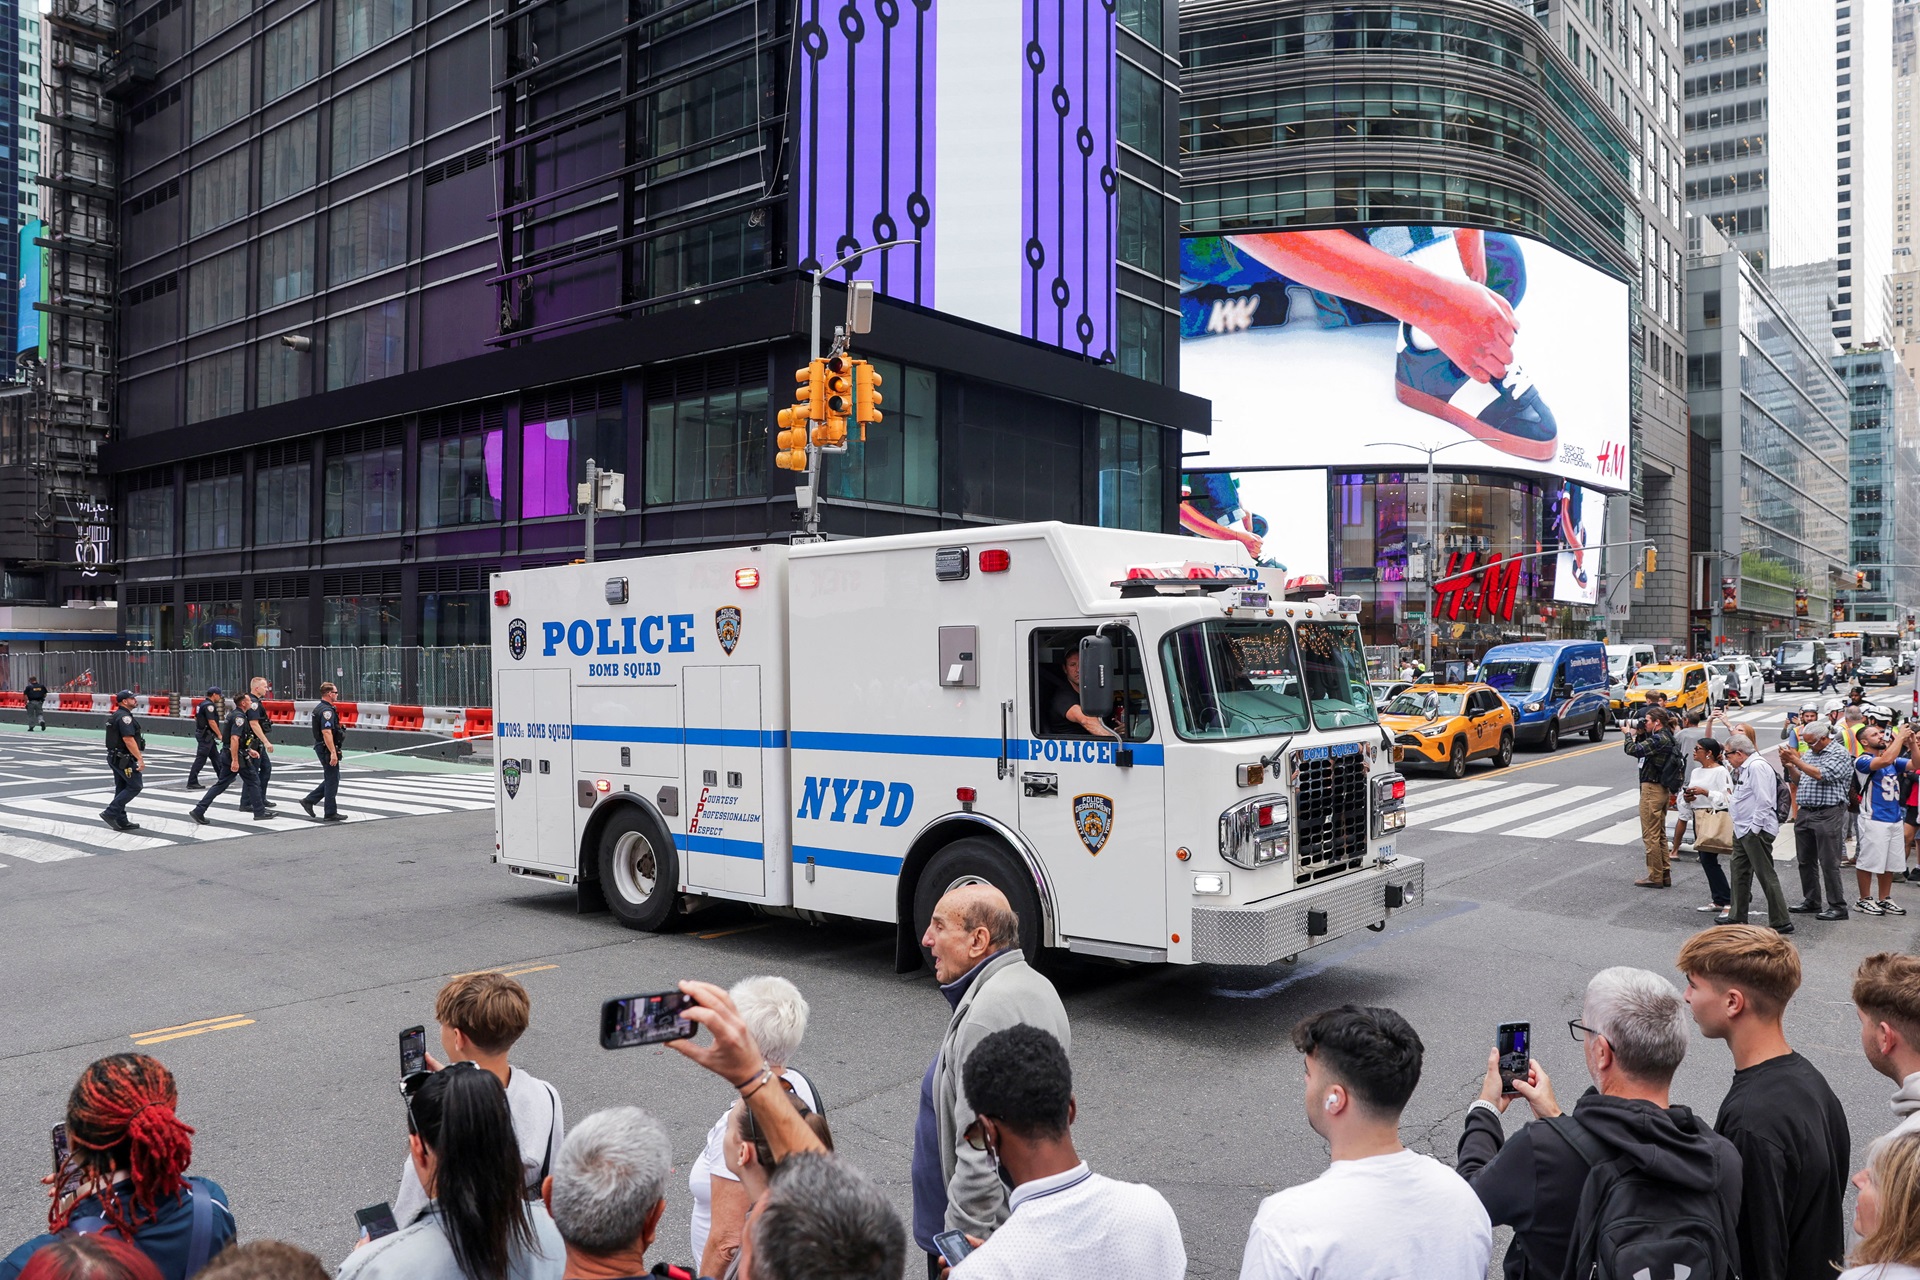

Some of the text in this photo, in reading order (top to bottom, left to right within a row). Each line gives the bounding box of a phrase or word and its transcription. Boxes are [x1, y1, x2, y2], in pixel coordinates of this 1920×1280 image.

[1596, 439, 1626, 481] H&M
[1432, 551, 1523, 621] H&M
[542, 613, 695, 657] POLICE
[589, 662, 661, 679] BOMB SQUAD
[505, 722, 521, 738] 7093
[527, 722, 546, 739] BOMB
[548, 723, 571, 743] SQUAD
[1030, 739, 1110, 764] POLICE
[1303, 747, 1329, 760] BOMB
[1331, 742, 1360, 758] SQUAD
[700, 787, 739, 805] COURTESY
[797, 776, 914, 827] NYPD
[1082, 796, 1104, 804] POLICE
[694, 802, 761, 823] PROFESSIONALISM
[1075, 802, 1112, 815] DEPARTMENT
[689, 818, 723, 836] RESPECT
